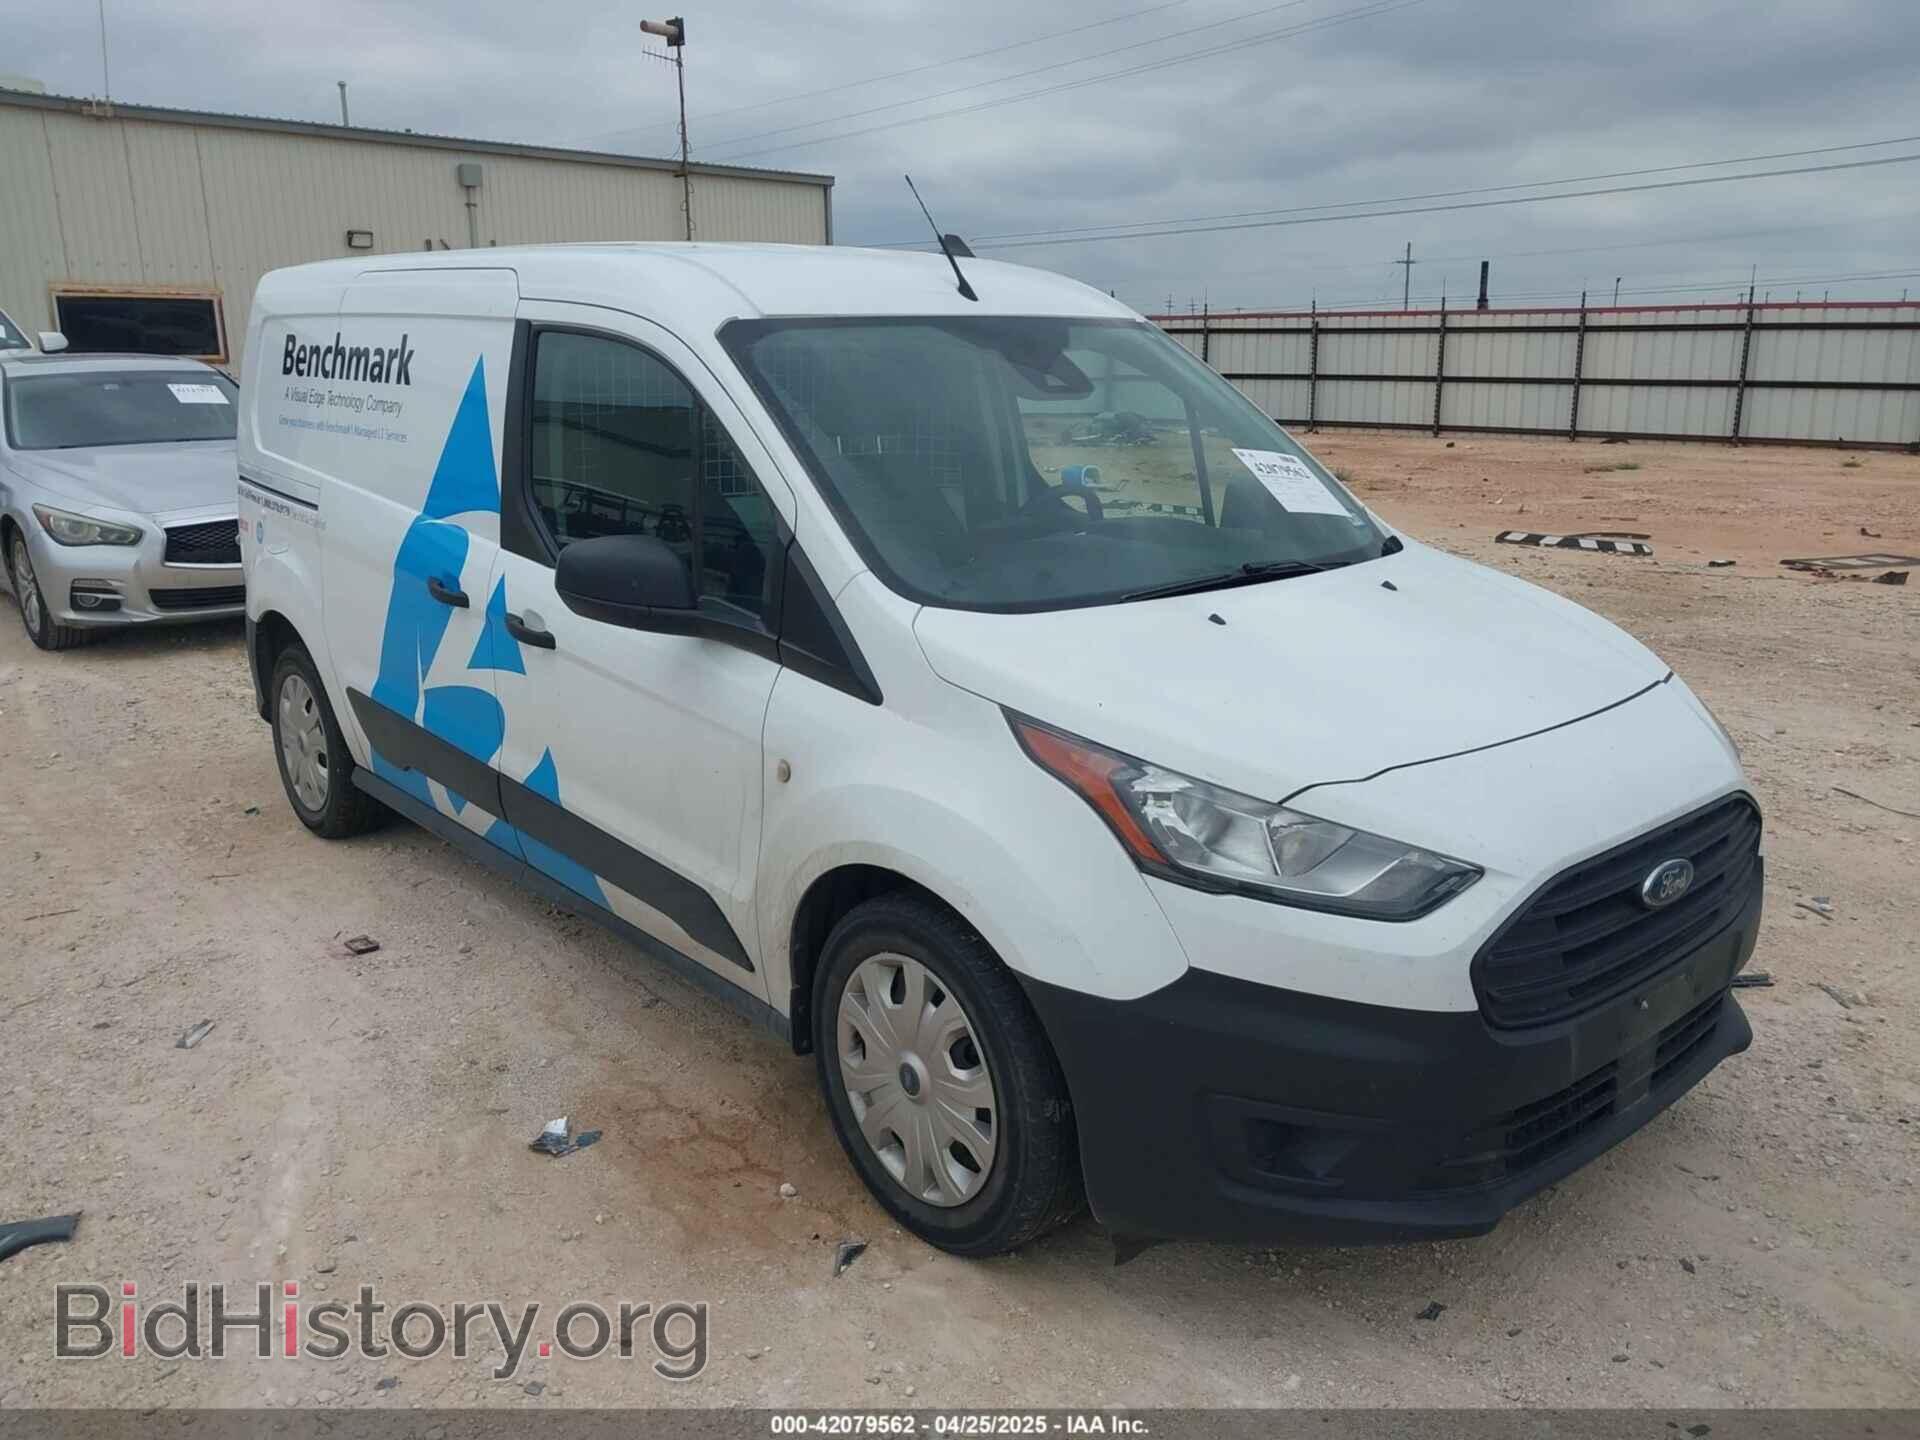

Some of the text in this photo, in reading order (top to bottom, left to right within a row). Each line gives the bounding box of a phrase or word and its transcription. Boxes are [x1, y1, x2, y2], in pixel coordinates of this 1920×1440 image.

[282, 332, 415, 386] Benchmark
[308, 388, 325, 408] Edge
[328, 390, 363, 413] Technology
[367, 394, 403, 418] Company
[1660, 869, 1688, 898] Ford
